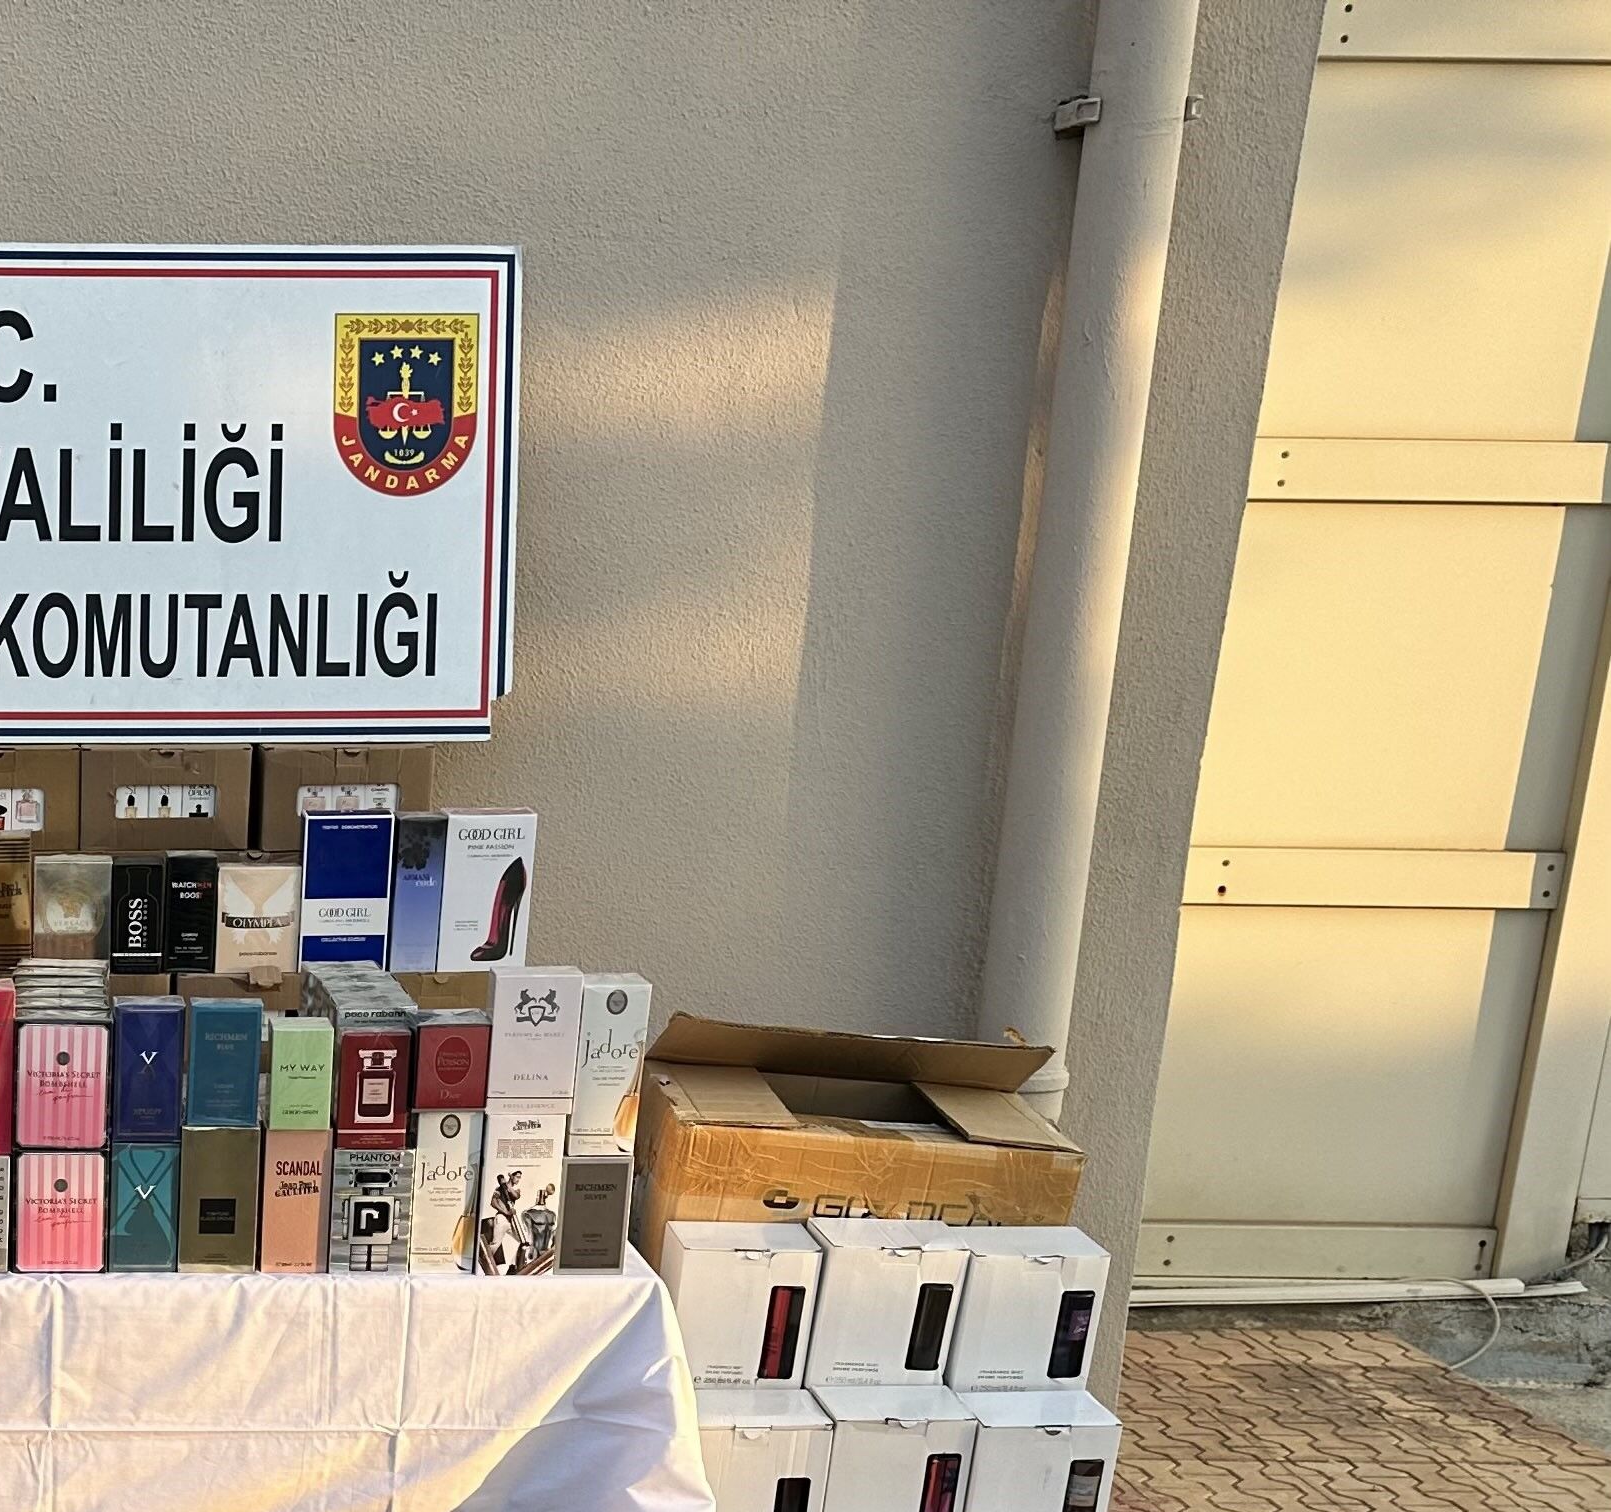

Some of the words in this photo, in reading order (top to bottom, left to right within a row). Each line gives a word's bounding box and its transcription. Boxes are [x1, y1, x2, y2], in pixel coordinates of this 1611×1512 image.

[341, 434, 470, 490] JANDARMA
[458, 828, 492, 841] GOOD
[493, 827, 526, 840] GIRL
[346, 907, 372, 917] GIRL
[128, 898, 144, 948] BOSS
[279, 1064, 297, 1073] MY
[299, 1063, 326, 1072] WAY
[513, 1073, 550, 1081] DELINA
[349, 1153, 401, 1163] PHANTOM
[275, 1160, 323, 1177] SCANDAL
